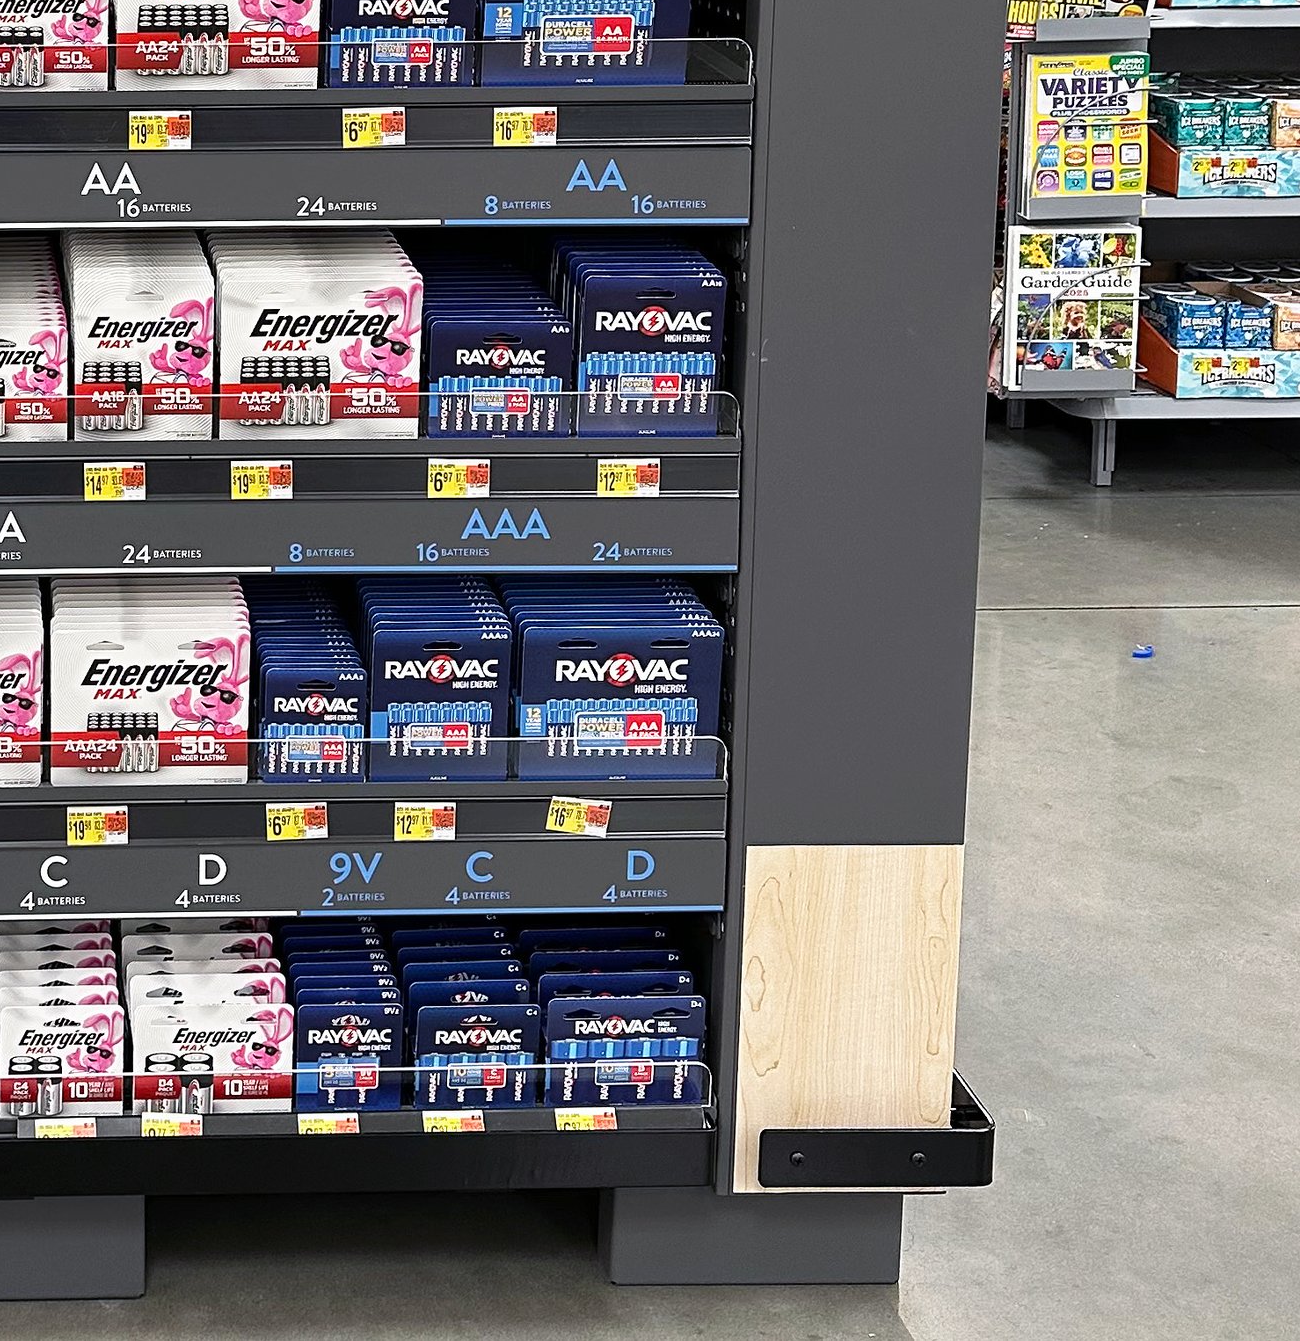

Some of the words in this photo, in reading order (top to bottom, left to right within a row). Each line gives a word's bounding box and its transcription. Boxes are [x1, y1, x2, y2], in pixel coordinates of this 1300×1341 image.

[497, 7, 512, 18] 12
[1008, 0, 1064, 25] HOURS!
[1040, 77, 1140, 96] VARIETY
[1053, 95, 1128, 109] PUZZLES
[80, 162, 142, 196] AA
[565, 158, 628, 192] AA
[116, 197, 141, 218] 16
[142, 203, 192, 213] BATTERIES
[484, 195, 499, 215] 8
[501, 200, 552, 210] BATTERIES
[1021, 276, 1079, 288] Garden
[1082, 275, 1132, 288] Guide
[250, 307, 398, 343] Energizer
[594, 305, 713, 336] RAYOVAC
[239, 391, 281, 405] AA24
[249, 403, 270, 412] PACK
[460, 507, 551, 540] AAA
[122, 544, 152, 564] 24
[153, 549, 202, 559] BATTERIES
[289, 543, 303, 563] 8
[306, 548, 355, 558] BATTERIES
[592, 541, 622, 562] 24
[623, 547, 673, 557] BATTERIES
[81, 660, 227, 695] Energizer
[385, 653, 499, 684] RAYOVAC
[40, 855, 69, 888] C
[198, 853, 227, 886] D
[329, 852, 383, 885] 9V
[465, 850, 494, 883] C
[626, 849, 656, 881] D
[19, 891, 36, 911] 4
[37, 896, 86, 906] BATTERIES
[321, 887, 335, 907] 2
[336, 892, 386, 902] BATTERIES
[444, 886, 461, 905] 4
[462, 891, 511, 901] BATTERIES
[602, 884, 618, 903] 4
[619, 889, 668, 899] BATTERIES
[172, 1027, 254, 1047] Energizer
[435, 1027, 522, 1047] RAYOVAC
